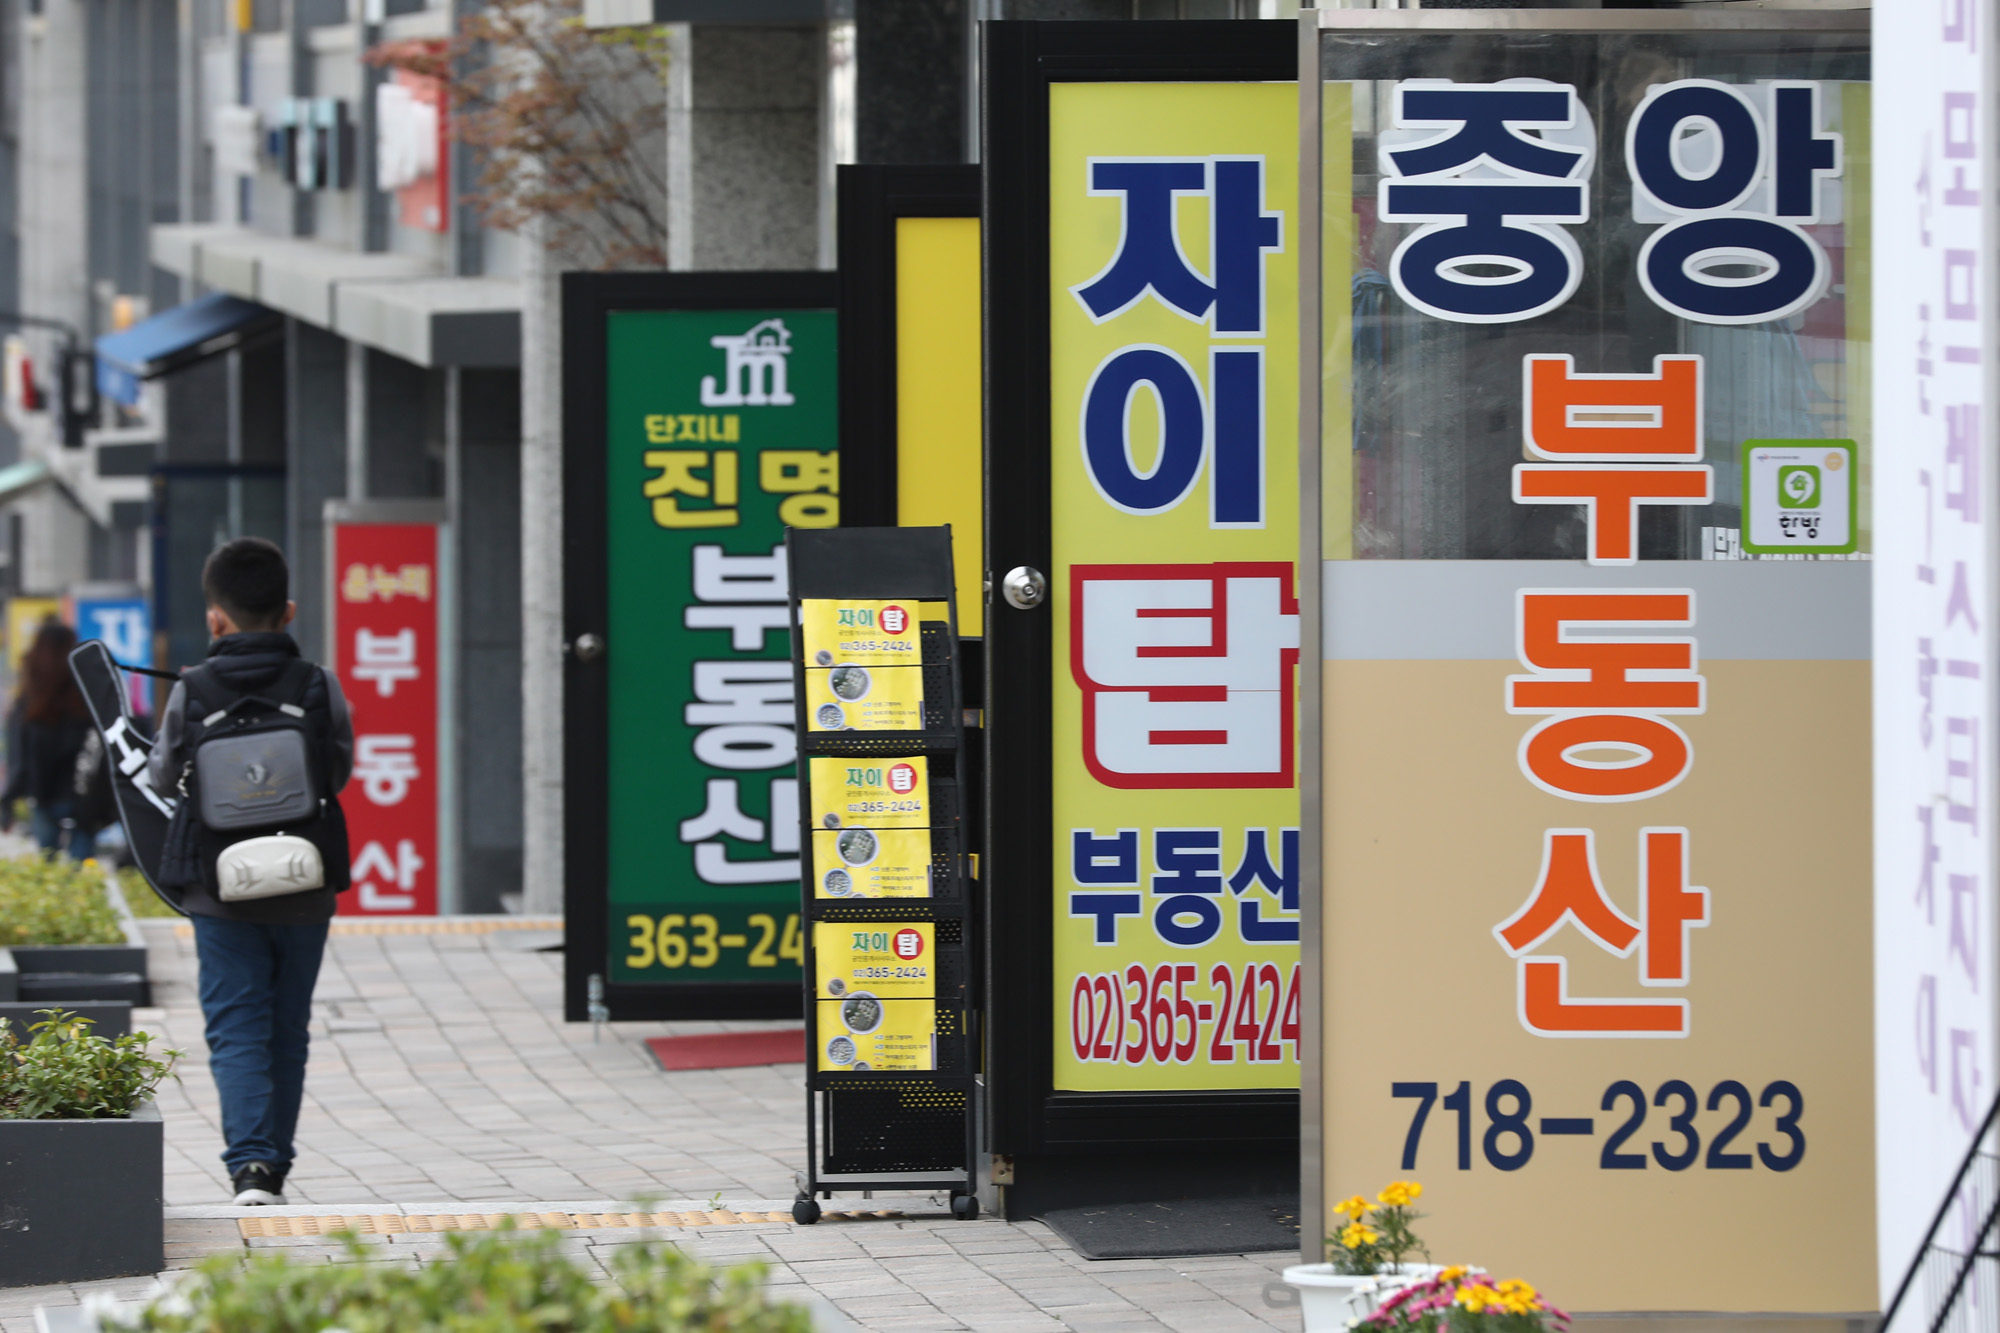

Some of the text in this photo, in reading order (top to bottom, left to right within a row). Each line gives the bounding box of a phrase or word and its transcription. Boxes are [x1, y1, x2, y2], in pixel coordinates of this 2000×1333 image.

[1378, 78, 1843, 325] 중앙
[645, 414, 740, 443] 단지내
[1779, 515, 1821, 539] 한방
[837, 608, 874, 627] 자이
[1492, 353, 1714, 1038] 부동산
[350, 627, 424, 910] 부동산
[846, 768, 882, 787] 자이
[852, 932, 889, 952] 자이
[1070, 960, 1300, 1066] 02)365-2424
[1391, 1078, 1806, 1172] 718-2323
